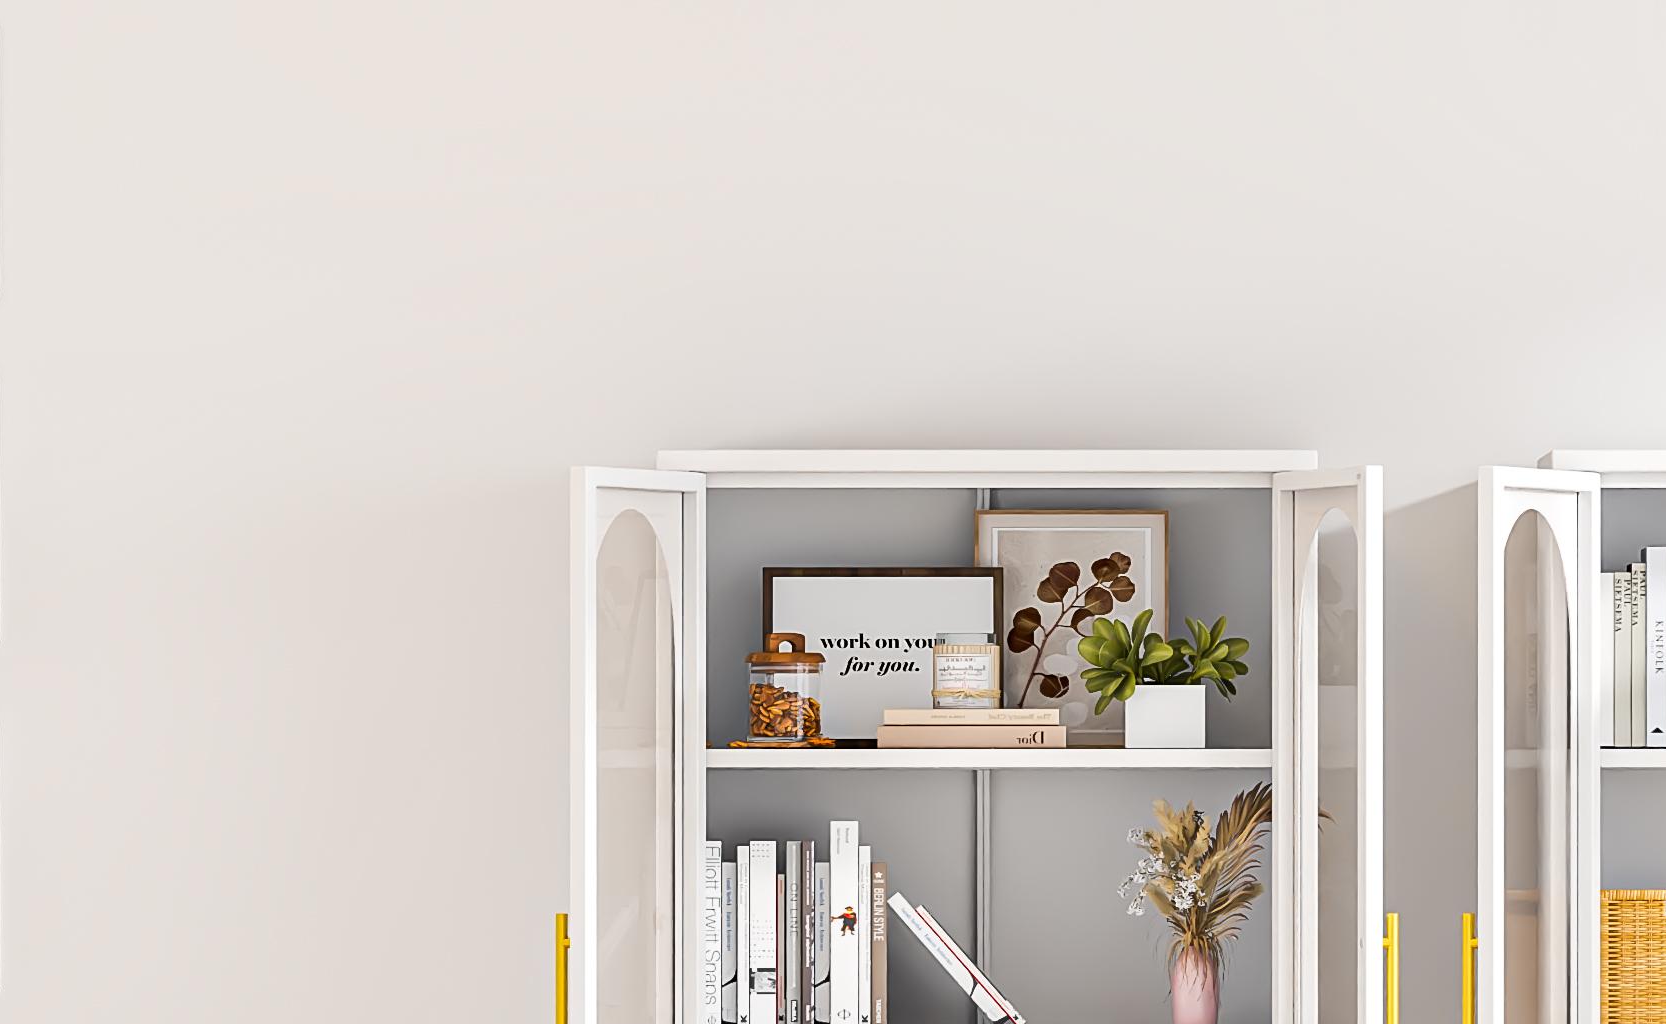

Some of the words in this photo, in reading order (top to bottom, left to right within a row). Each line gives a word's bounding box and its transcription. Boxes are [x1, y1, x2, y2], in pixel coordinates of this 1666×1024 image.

[820, 633, 871, 649] work
[875, 638, 900, 649] on
[840, 656, 875, 676] for
[877, 660, 920, 676] you.
[874, 887, 884, 916] BERLIN
[874, 917, 884, 942] STYLE
